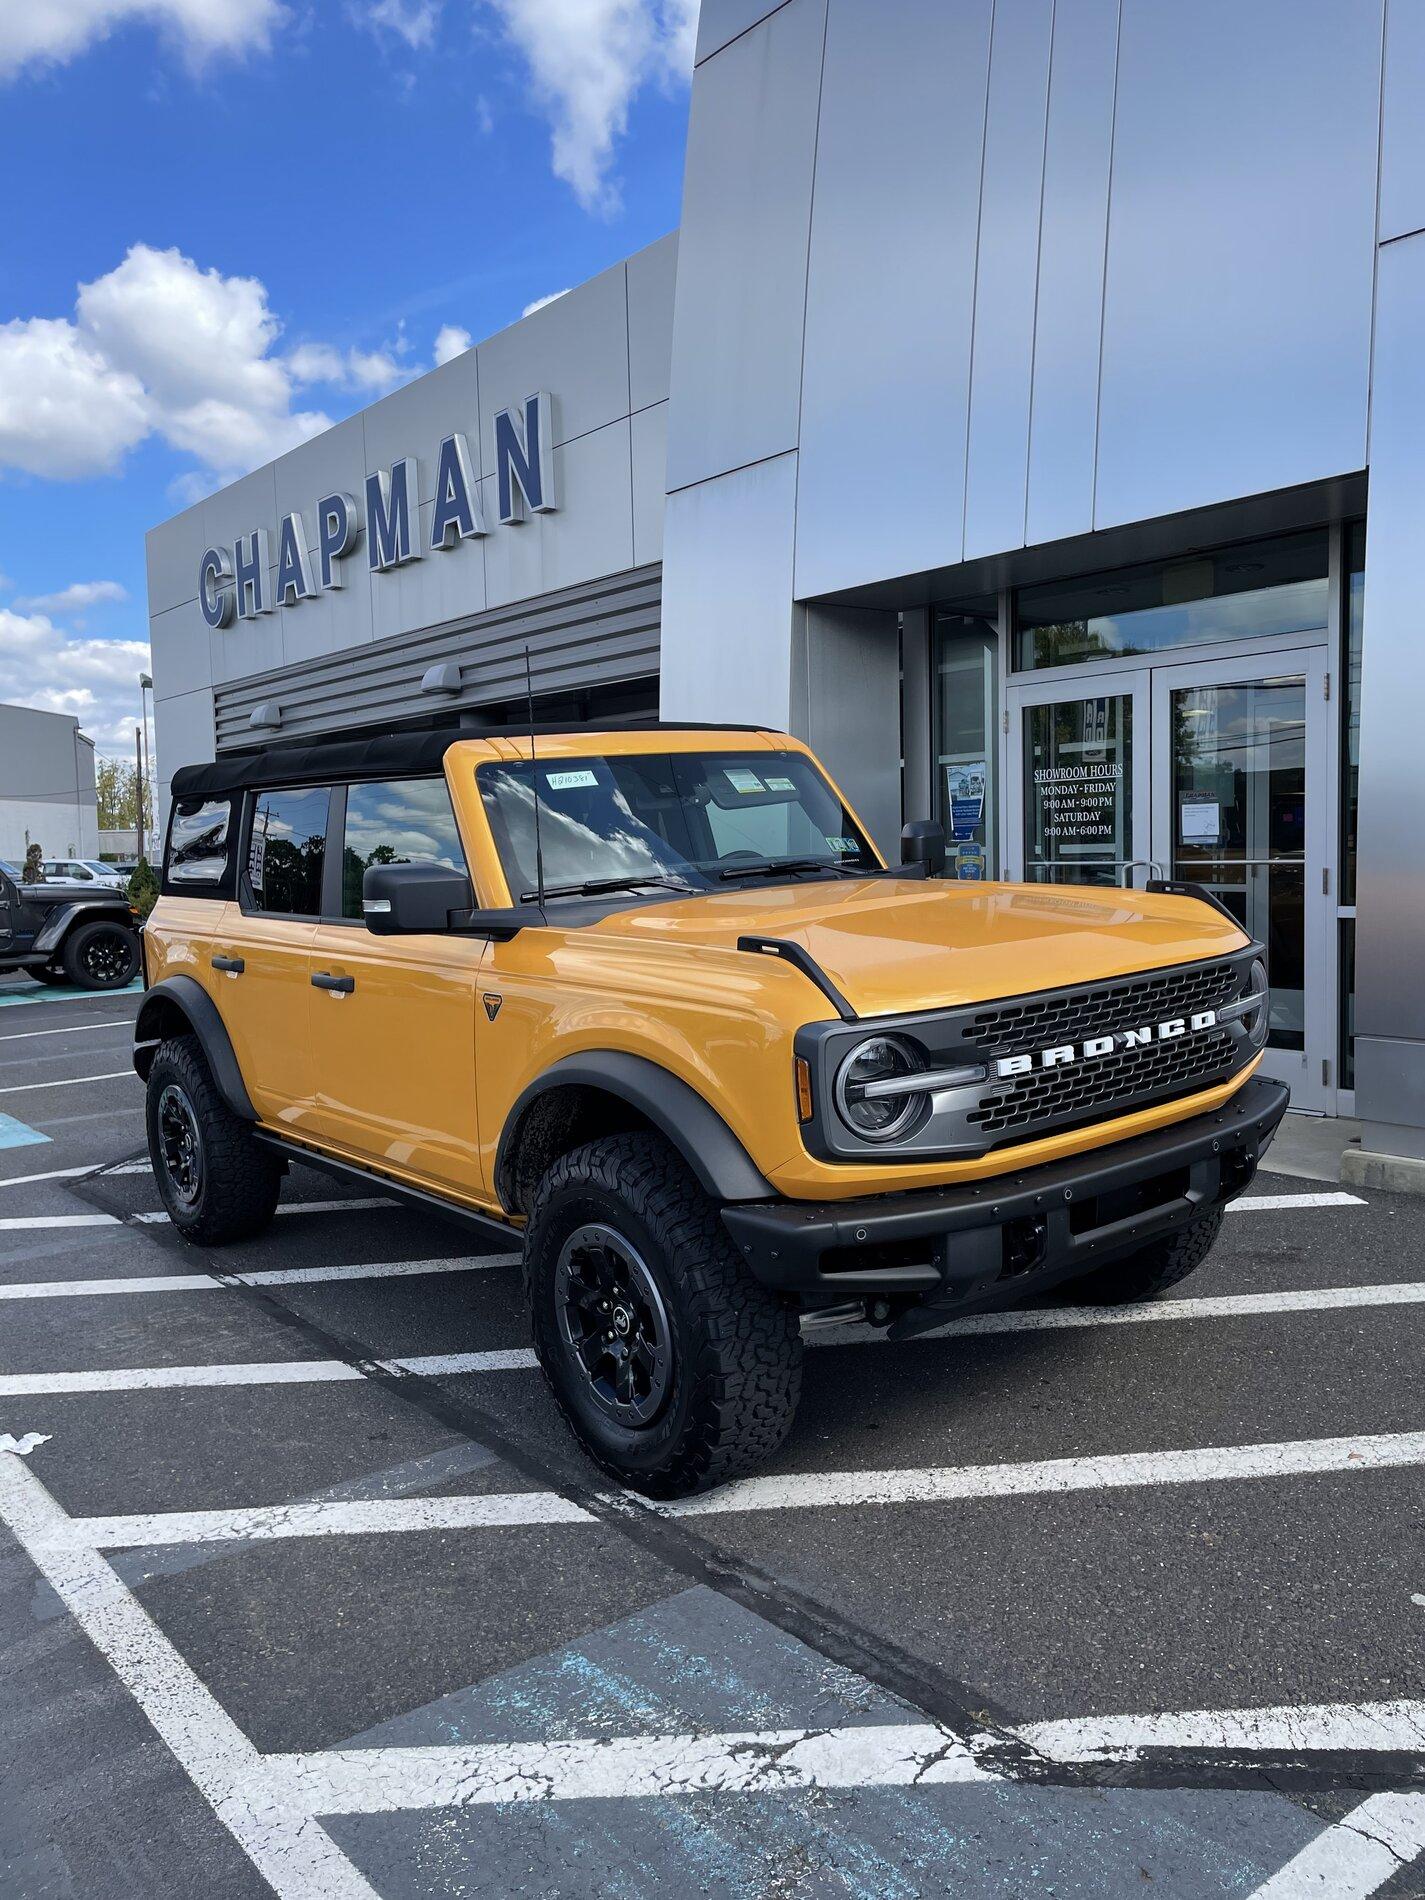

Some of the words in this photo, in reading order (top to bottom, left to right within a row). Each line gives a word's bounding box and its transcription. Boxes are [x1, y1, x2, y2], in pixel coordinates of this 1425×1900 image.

[198, 391, 557, 629] CHAPMAN
[1034, 766, 1087, 781] SHOWROOM
[1090, 764, 1123, 777] HOURS
[1053, 812, 1101, 823] SATURDAY
[997, 1010, 1216, 1077] BRONCO
